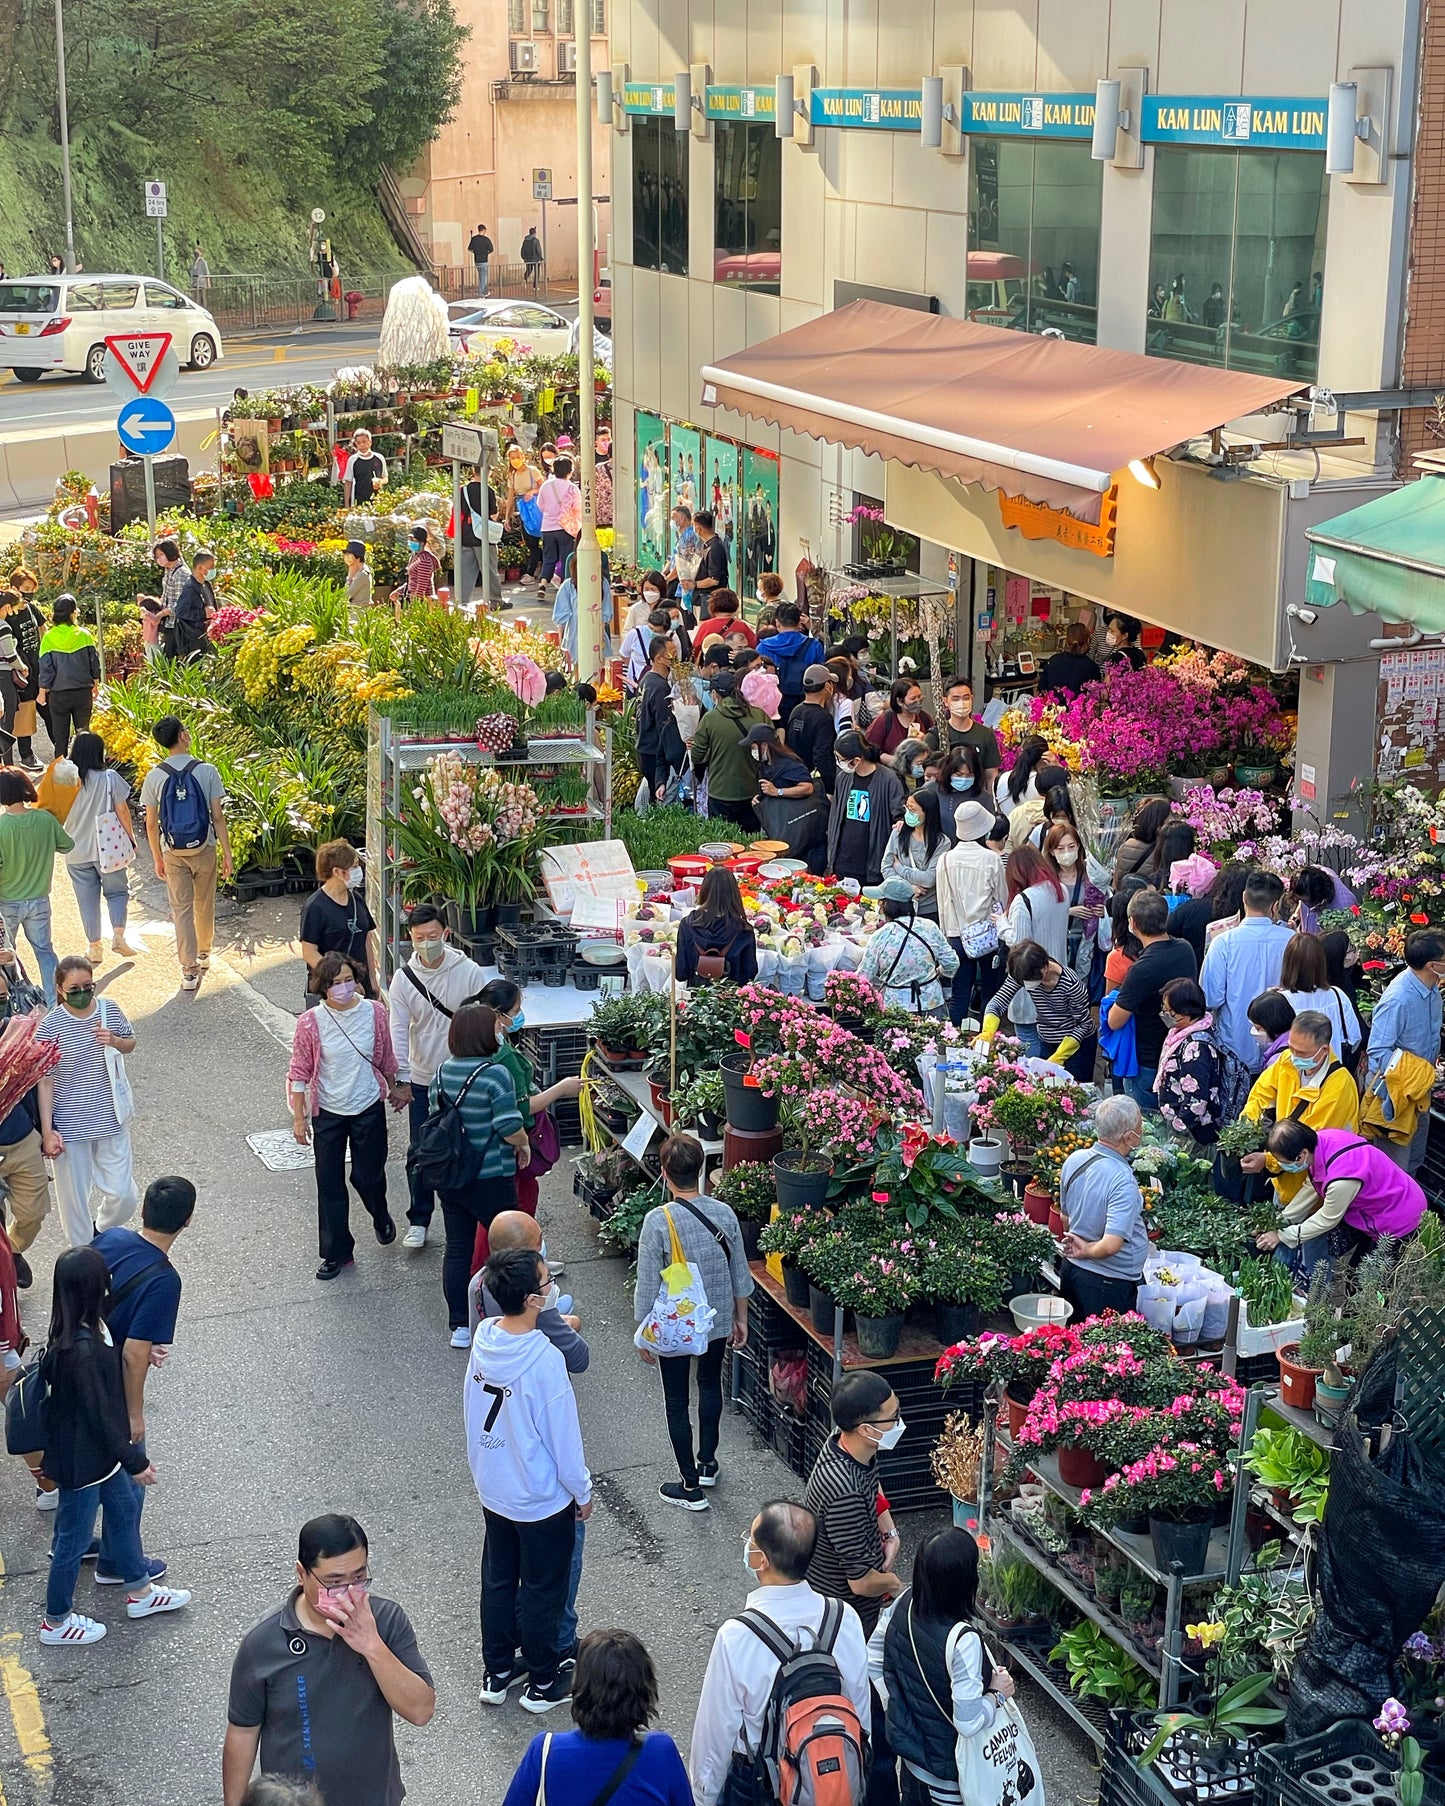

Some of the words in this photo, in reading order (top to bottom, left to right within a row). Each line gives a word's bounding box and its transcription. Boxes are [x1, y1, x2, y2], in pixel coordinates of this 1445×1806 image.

[709, 94, 725, 110] KAM
[726, 95, 740, 110] LUN
[755, 95, 773, 112] KAM
[824, 98, 844, 115] KAM
[845, 98, 862, 116] LUN
[880, 99, 902, 117] KAM
[972, 101, 997, 121] KAM
[999, 102, 1020, 122] LUN
[1044, 104, 1071, 124] KAM
[1157, 107, 1190, 131] KAM
[1193, 109, 1221, 132] LUN
[1252, 110, 1288, 134] KAM
[1292, 111, 1324, 136] LUN
[128, 341, 150, 349] GIVE
[848, 793, 857, 816] CHUMS
[483, 1383, 504, 1433] 7
[297, 1674, 311, 1749] SENNHEISER
